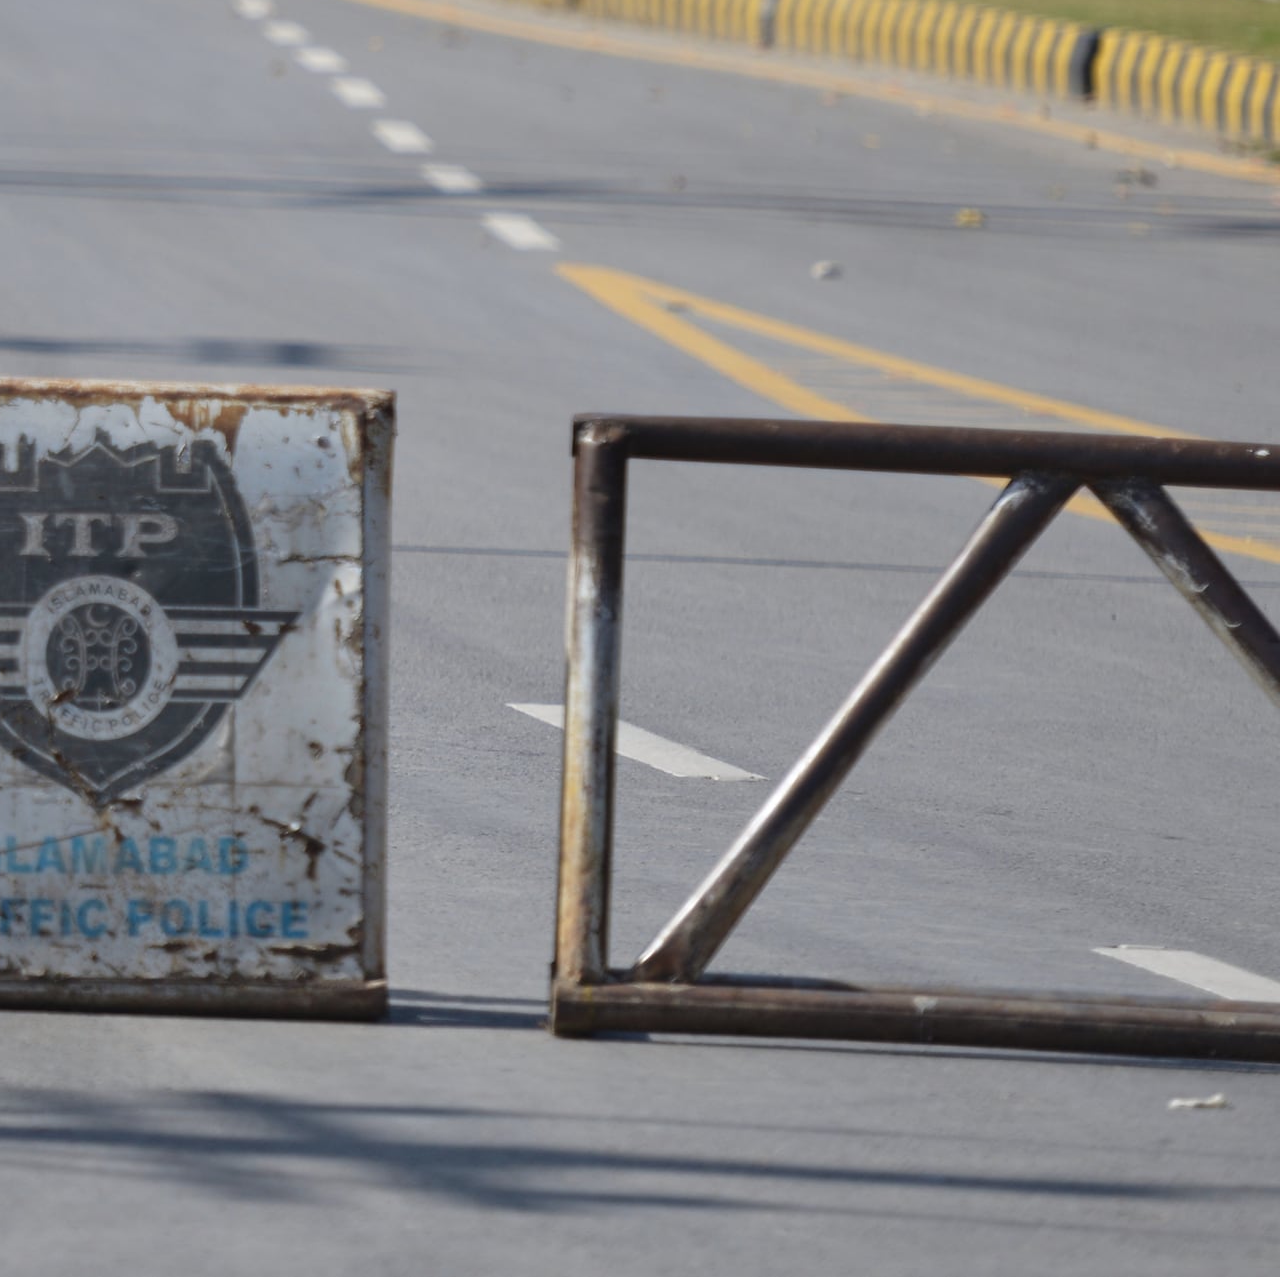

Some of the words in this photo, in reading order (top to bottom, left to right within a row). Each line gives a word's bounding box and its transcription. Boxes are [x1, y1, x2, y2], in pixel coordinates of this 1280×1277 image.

[18, 511, 178, 558] ITP
[47, 583, 152, 614] ISLAMABAD
[32, 676, 101, 730] TRFFIC
[127, 898, 310, 940] POLICE
